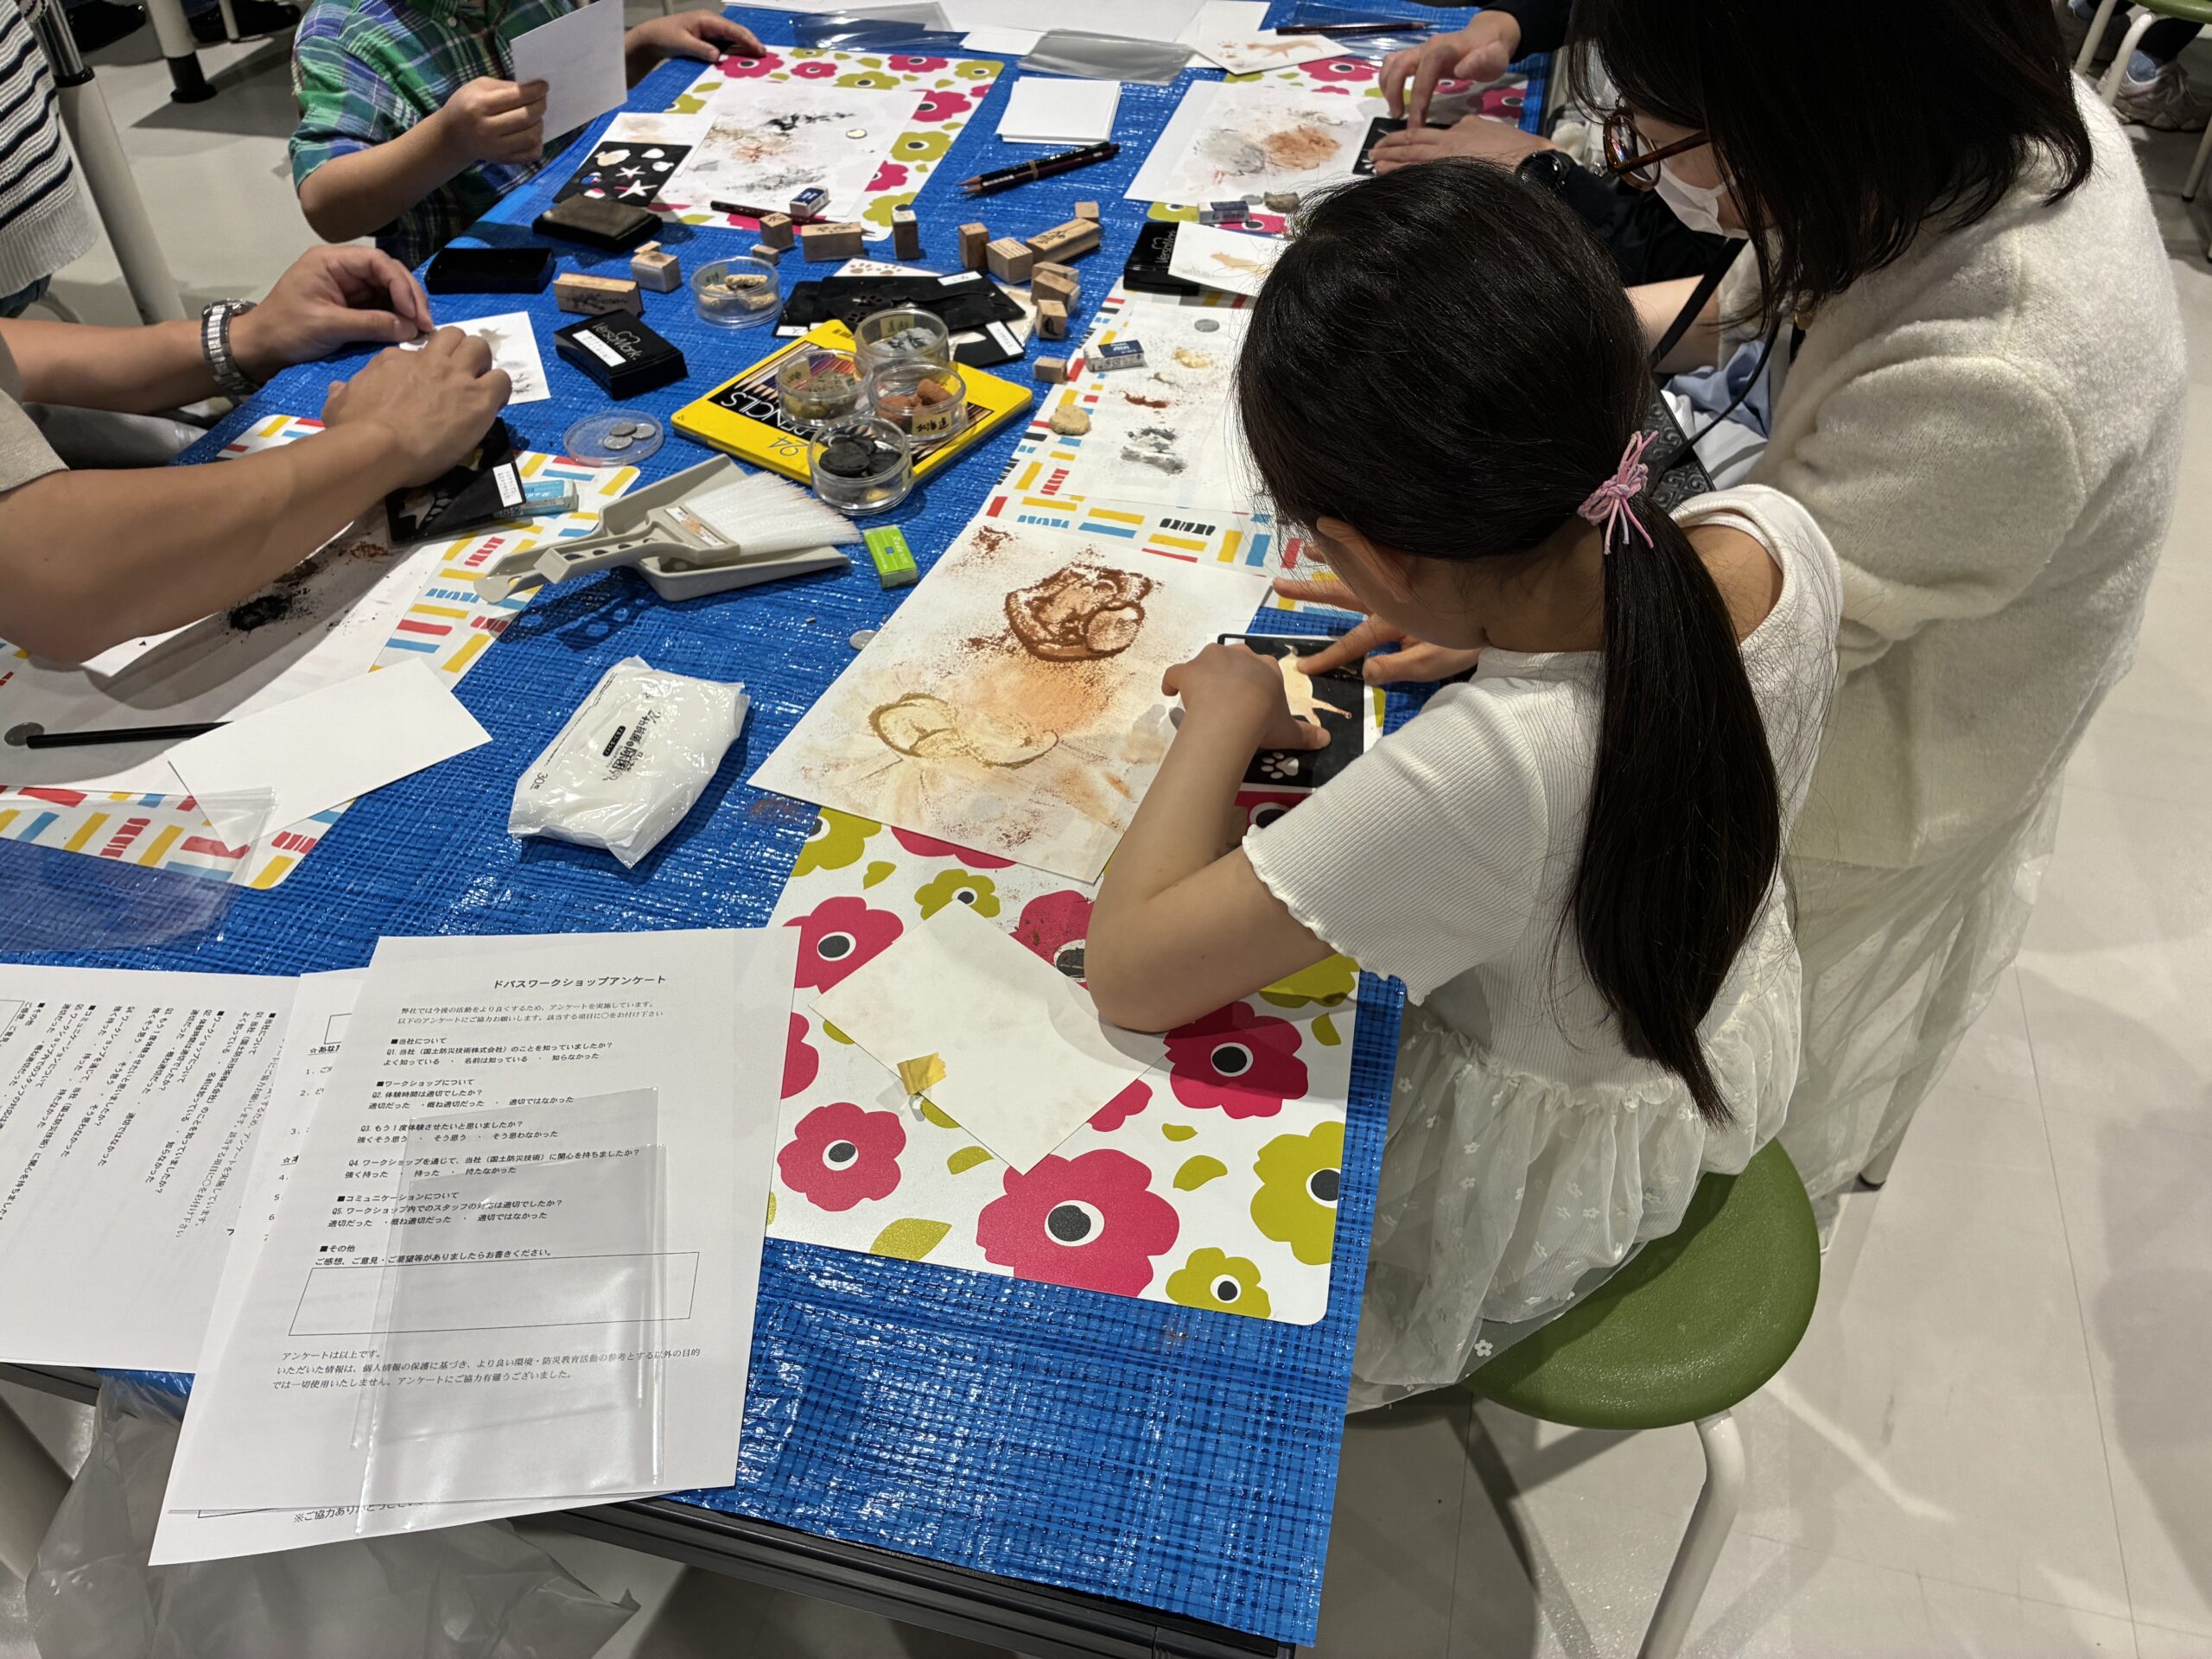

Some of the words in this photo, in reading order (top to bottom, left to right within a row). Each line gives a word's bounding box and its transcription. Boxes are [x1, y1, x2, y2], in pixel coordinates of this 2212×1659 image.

[551, 1052, 600, 1061] 知らなかった
[508, 1096, 575, 1106] 適切ではなかった
[434, 1134, 467, 1142] そう思う
[493, 1130, 558, 1140] そう思わなかった
[477, 1212, 548, 1222] 適切ではなかった
[328, 1244, 355, 1253] その他
